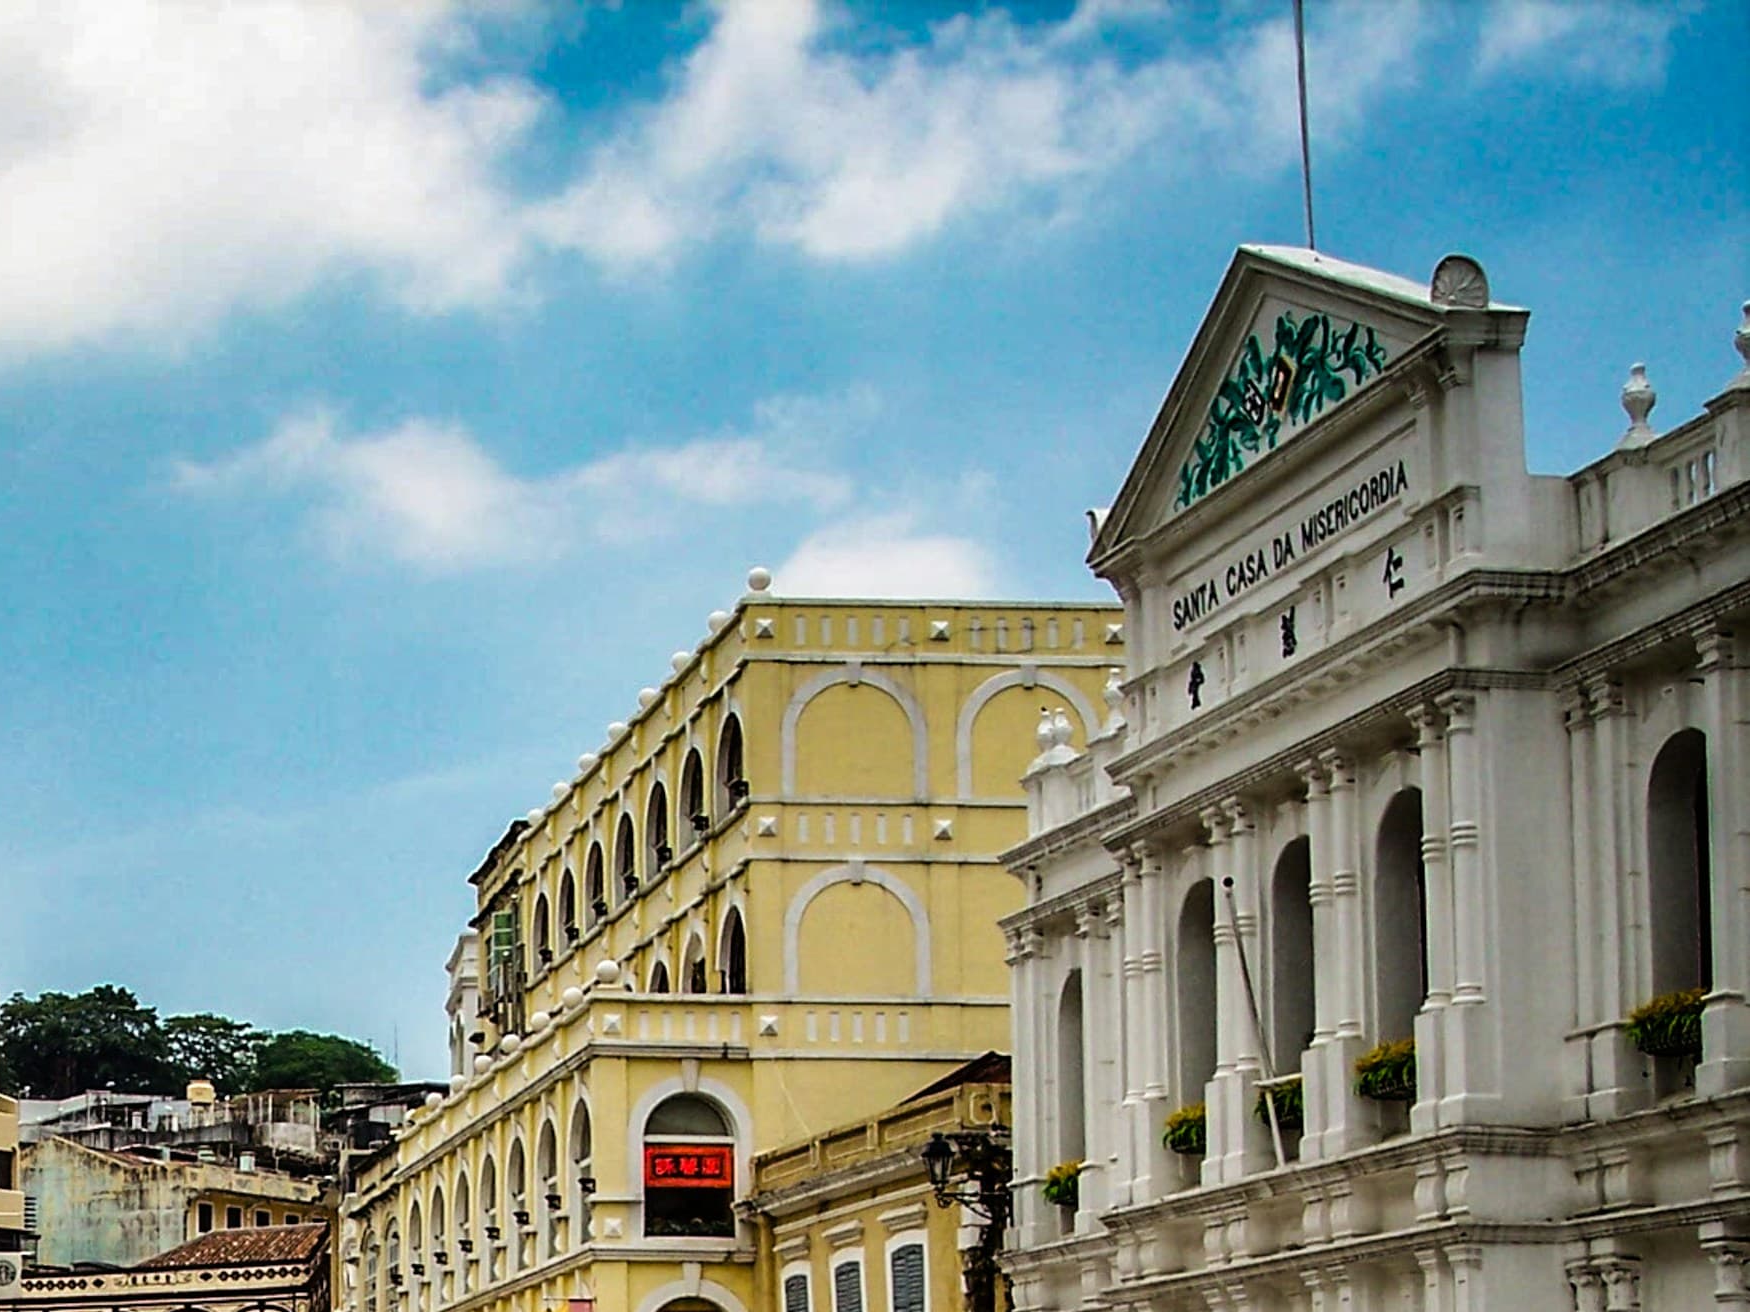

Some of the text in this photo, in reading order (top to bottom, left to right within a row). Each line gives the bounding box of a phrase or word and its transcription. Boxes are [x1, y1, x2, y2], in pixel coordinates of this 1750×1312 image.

[1173, 460, 1409, 631] SANTA CASA DA MISERICORDIA
